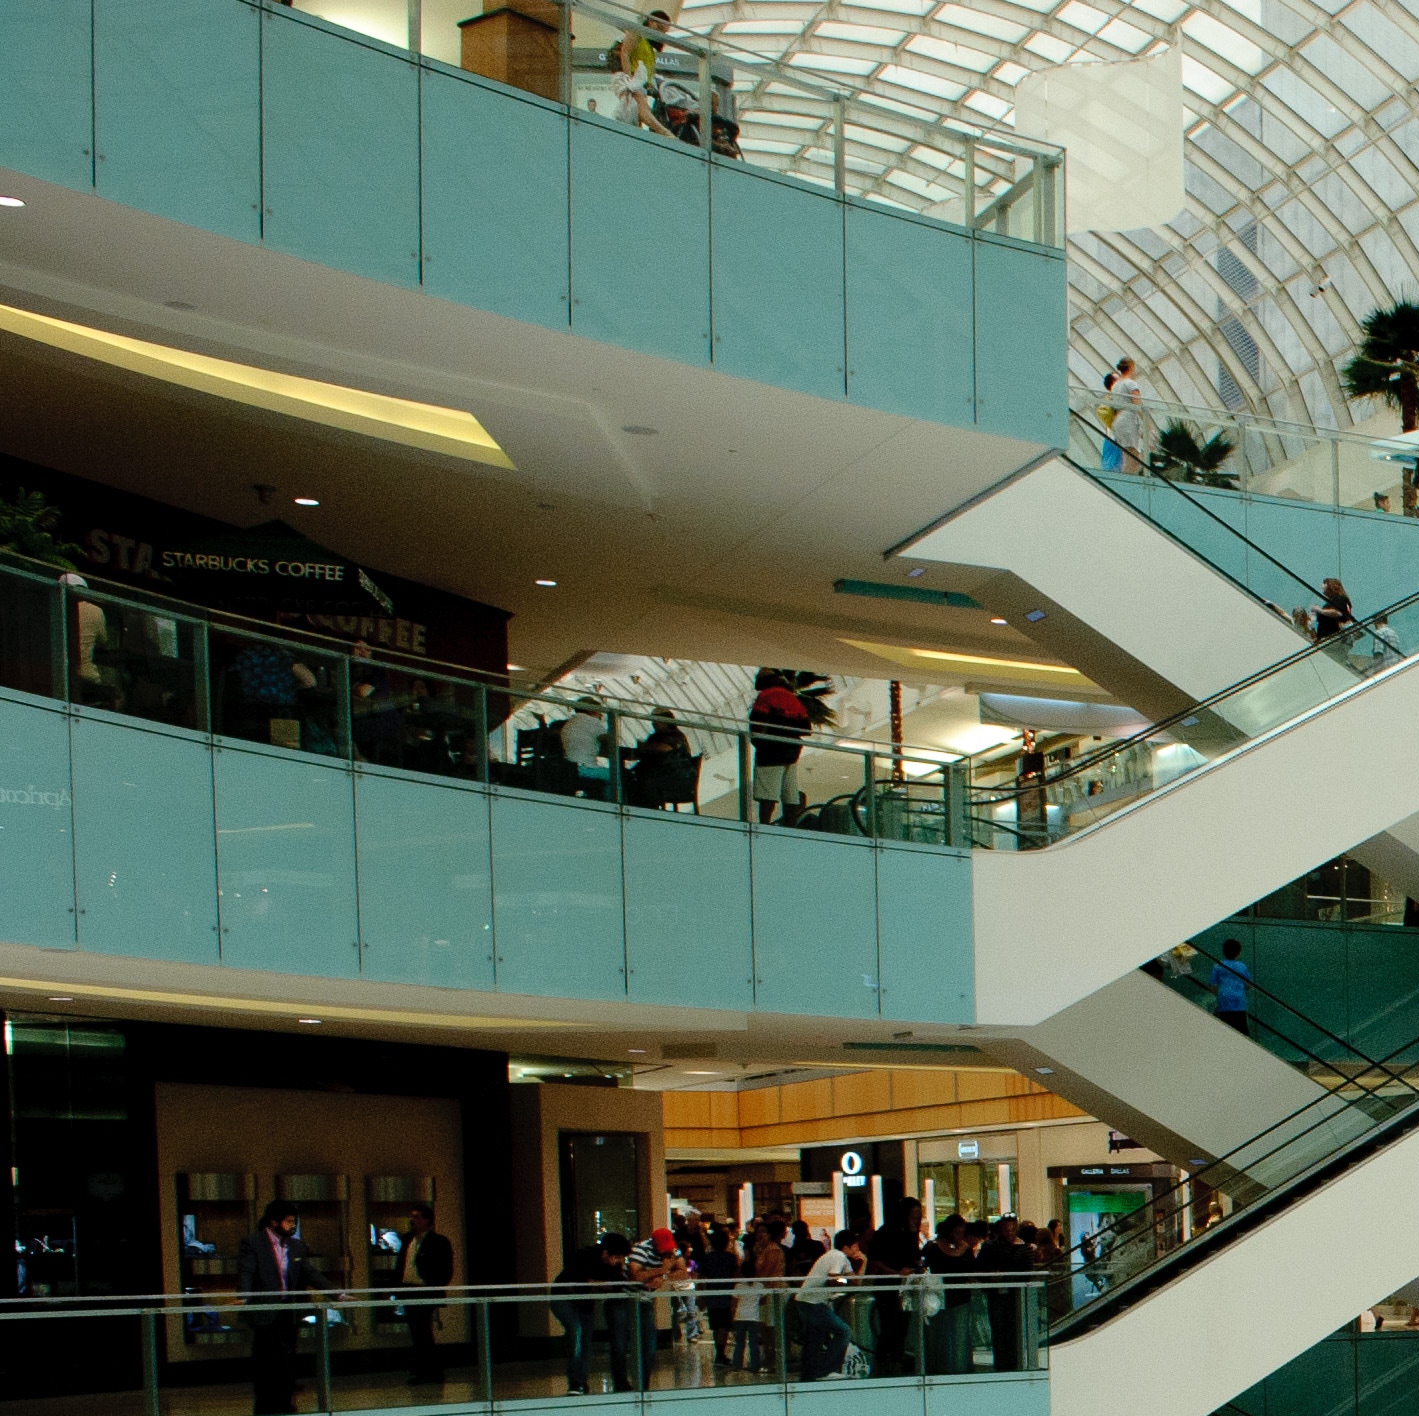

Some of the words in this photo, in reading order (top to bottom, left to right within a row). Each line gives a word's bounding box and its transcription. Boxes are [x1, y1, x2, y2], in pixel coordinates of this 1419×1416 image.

[656, 55, 680, 66] ALLAS
[160, 550, 270, 575] STARBUCKS
[274, 560, 346, 582] COFFEE
